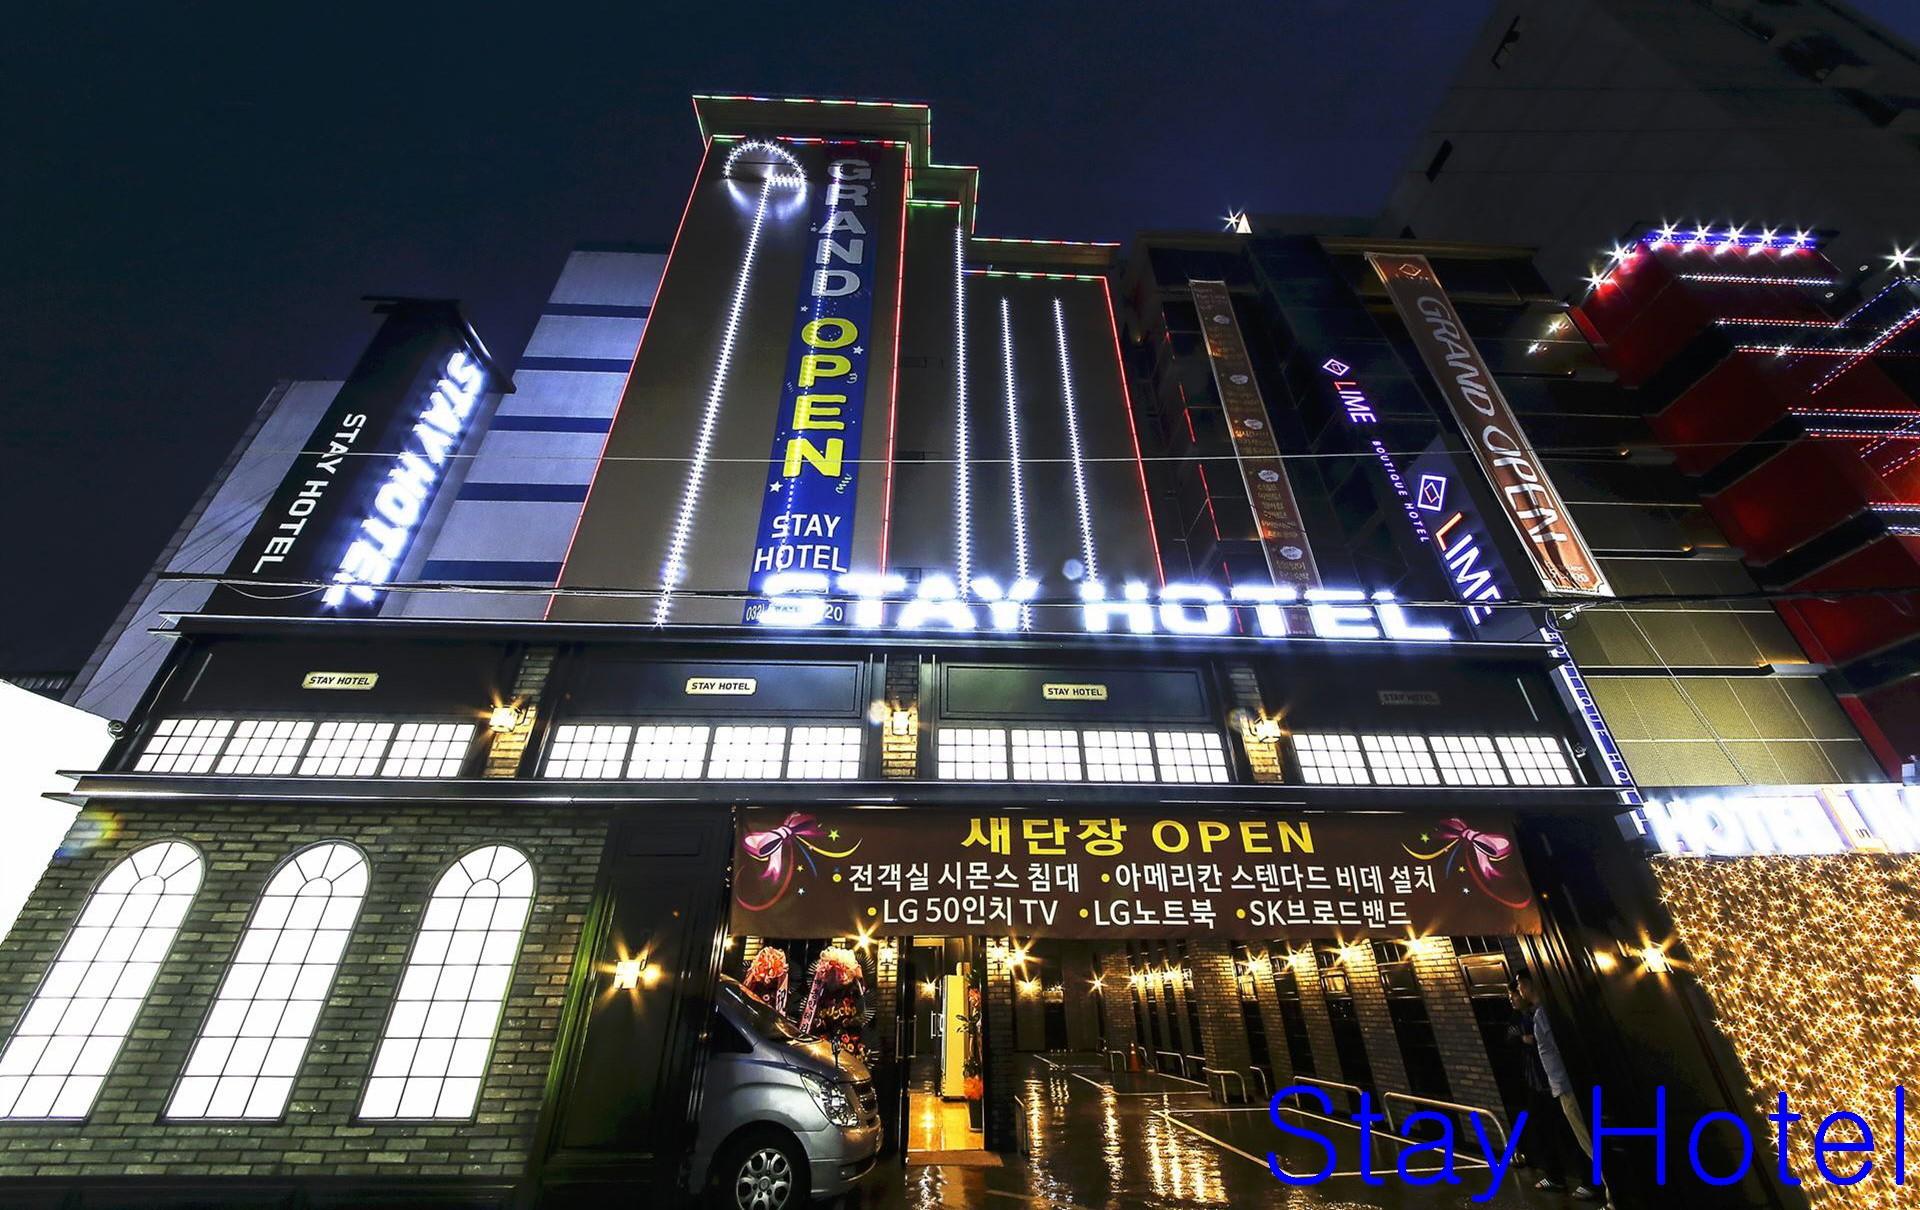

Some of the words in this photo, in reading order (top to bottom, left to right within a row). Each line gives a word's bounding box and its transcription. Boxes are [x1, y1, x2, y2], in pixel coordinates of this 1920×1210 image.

[811, 159, 872, 297] GRAND
[412, 352, 483, 465] STAY
[783, 317, 858, 477] OPEN
[1334, 381, 1377, 423] LIME
[1417, 296, 1496, 417] GRAND
[1482, 425, 1568, 544] OPEN
[316, 413, 367, 475] STAY
[1371, 439, 1409, 496] BOUTIQUE
[1404, 502, 1430, 543] HOTEL
[252, 480, 329, 574] HOTEL
[321, 450, 438, 608] HOTEL
[771, 513, 841, 538] STAY
[753, 543, 848, 573] HOTEL
[1435, 511, 1502, 626] LIME
[760, 571, 1041, 628] STAY
[1081, 580, 1453, 643] HOTEL
[308, 675, 336, 685] STAY
[337, 676, 371, 686] HOTEL
[691, 681, 716, 691] STAY
[718, 682, 751, 691] HOTEL
[1047, 687, 1070, 696] STAY
[1072, 688, 1103, 697] HOTEL
[960, 816, 1128, 857] 새단장
[1151, 819, 1316, 854] OPEN
[848, 862, 929, 893] 전객실
[937, 861, 1020, 890] 시몬스
[1027, 863, 1079, 893] 침대
[1115, 862, 1223, 893] 아메리칸
[1230, 863, 1331, 893] 스텐다드
[1335, 865, 1385, 895] 비데
[1389, 865, 1436, 894] 설치
[883, 898, 918, 924] LG
[925, 897, 1012, 926] 50인치
[1019, 899, 1058, 926] TV
[1094, 899, 1217, 930] LG노트북
[1249, 899, 1412, 929] SK브로드밴드
